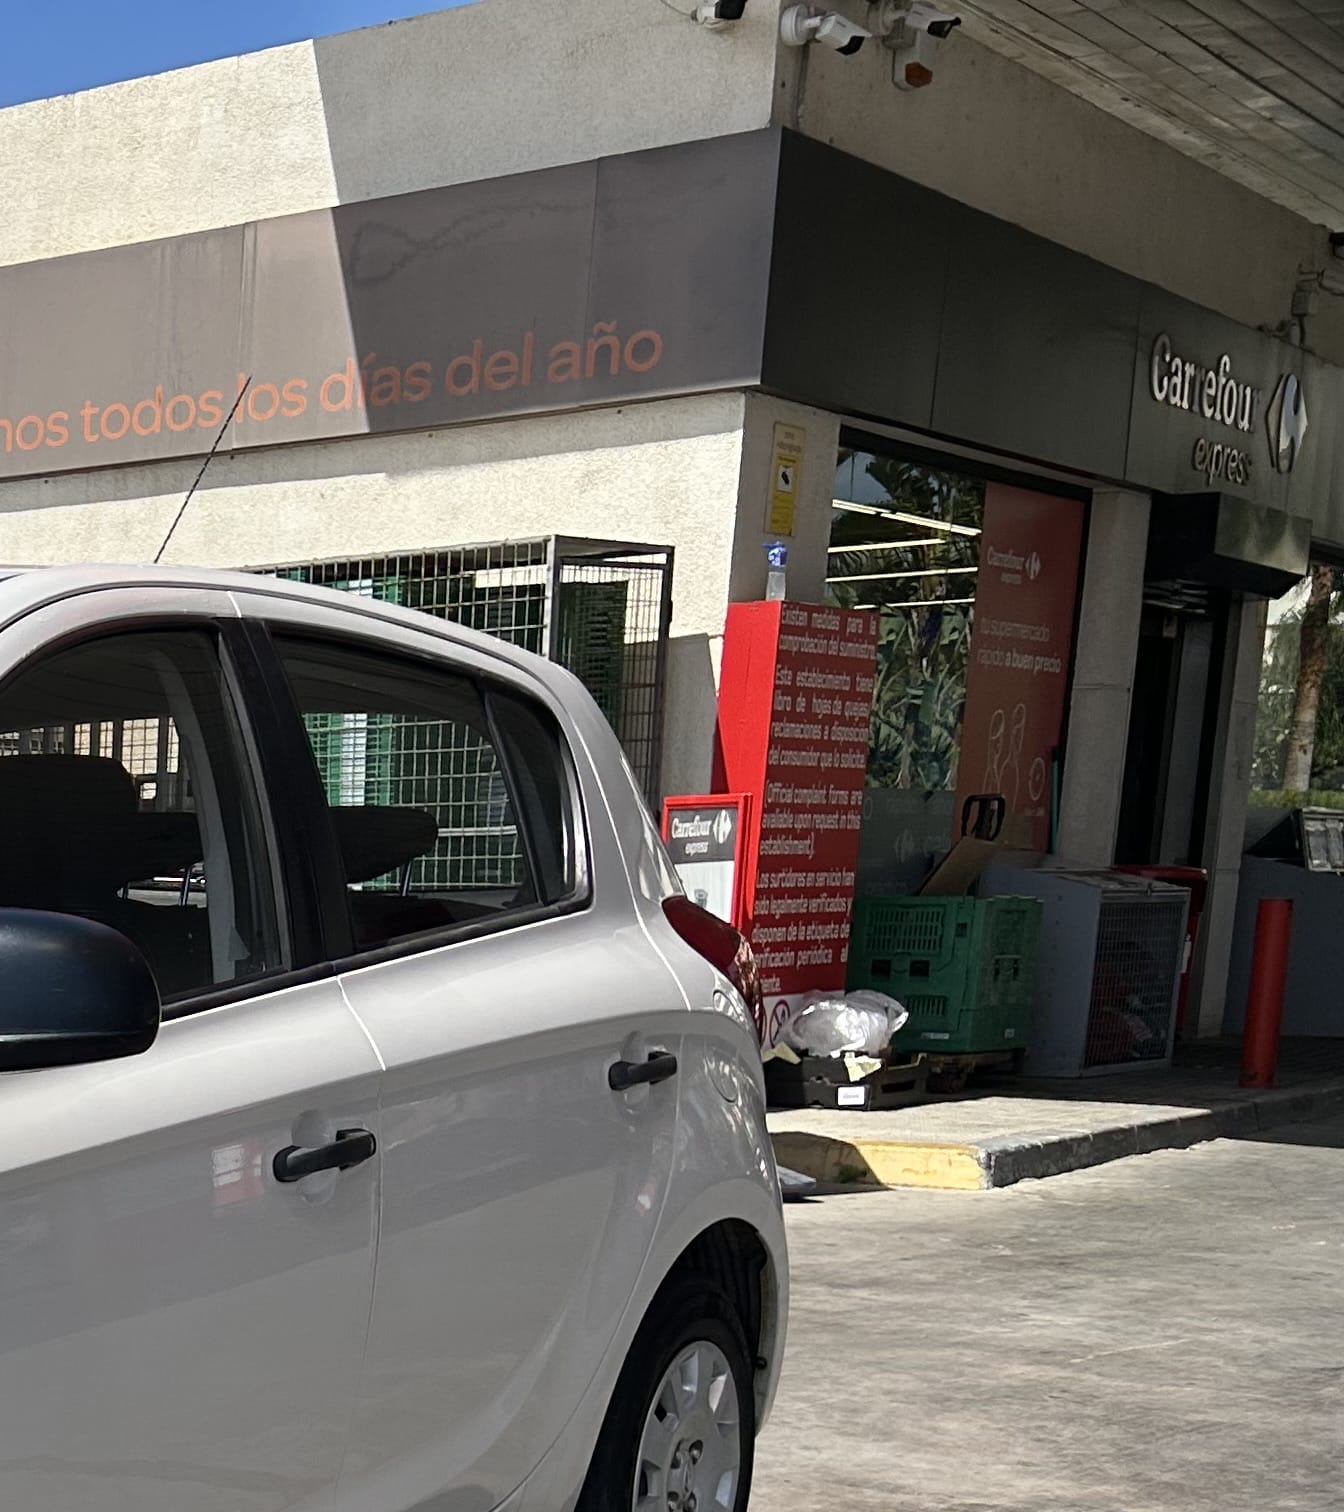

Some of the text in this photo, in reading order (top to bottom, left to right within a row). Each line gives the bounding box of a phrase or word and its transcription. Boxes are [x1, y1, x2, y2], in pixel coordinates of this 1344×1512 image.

[81, 386, 224, 442] todos
[235, 372, 308, 423] los
[320, 353, 431, 412] días
[445, 332, 534, 396] del
[546, 320, 663, 383] año
[1152, 334, 1262, 434] Carrefour
[847, 616, 863, 636] para
[828, 635, 839, 656] del
[775, 664, 792, 685] Este
[796, 667, 851, 692] establecimiento
[796, 691, 806, 712] de
[832, 695, 842, 715] de
[824, 725, 830, 739] a
[769, 744, 780, 766] del
[820, 751, 832, 772] que
[828, 784, 849, 806] forms
[850, 790, 863, 806] are
[793, 812, 811, 834] upon
[756, 869, 768, 889] Los
[770, 893, 808, 919] legalmente
[752, 922, 786, 947] disponen
[787, 921, 797, 942] de
[798, 920, 805, 942] la
[806, 920, 839, 945] etiqueta
[754, 946, 794, 969] erificación
[796, 942, 832, 971] periódica
